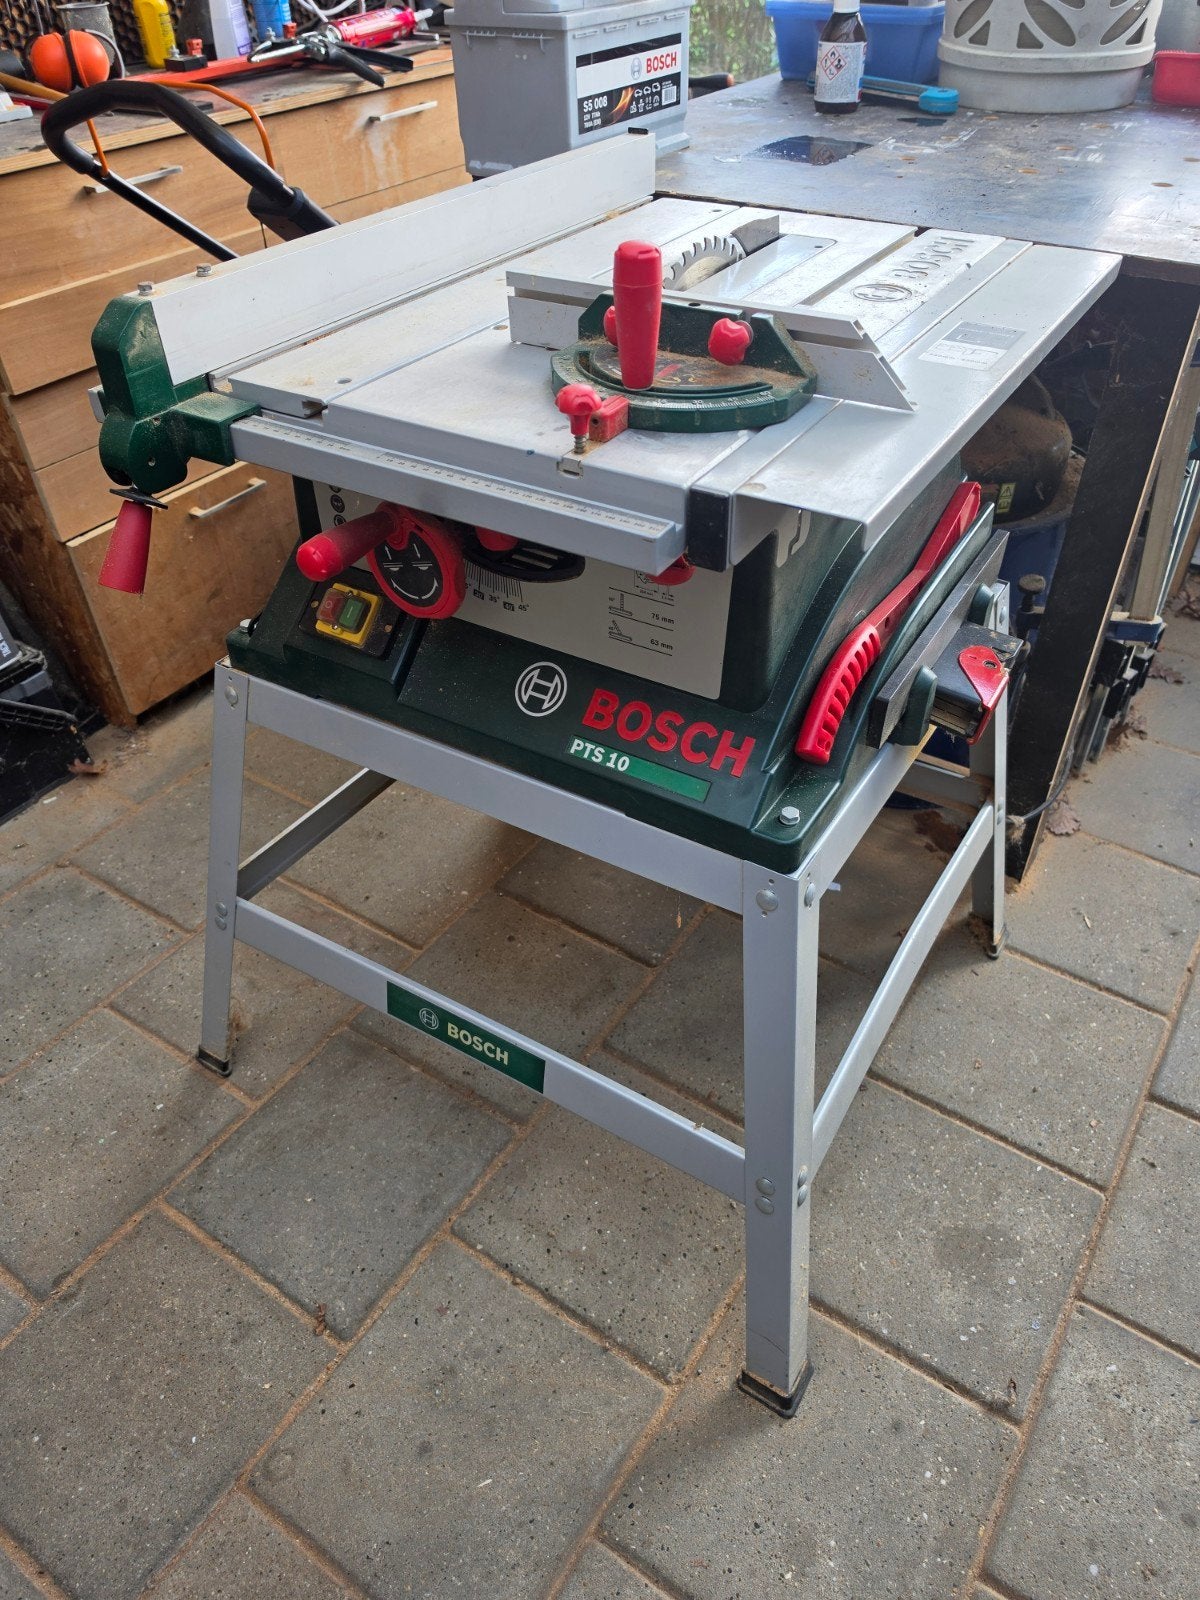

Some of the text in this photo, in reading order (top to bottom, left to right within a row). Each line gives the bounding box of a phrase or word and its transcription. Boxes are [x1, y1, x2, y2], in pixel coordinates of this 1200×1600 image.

[646, 51, 677, 74] BOSCH
[583, 95, 608, 112] S5 008
[890, 236, 976, 279] BOSCH
[651, 612, 675, 624] 75 mm
[650, 638, 673, 650] 63 mm
[582, 688, 757, 778] BOSCH
[569, 738, 630, 772] PTS 10
[447, 1021, 509, 1066] BOSCH
